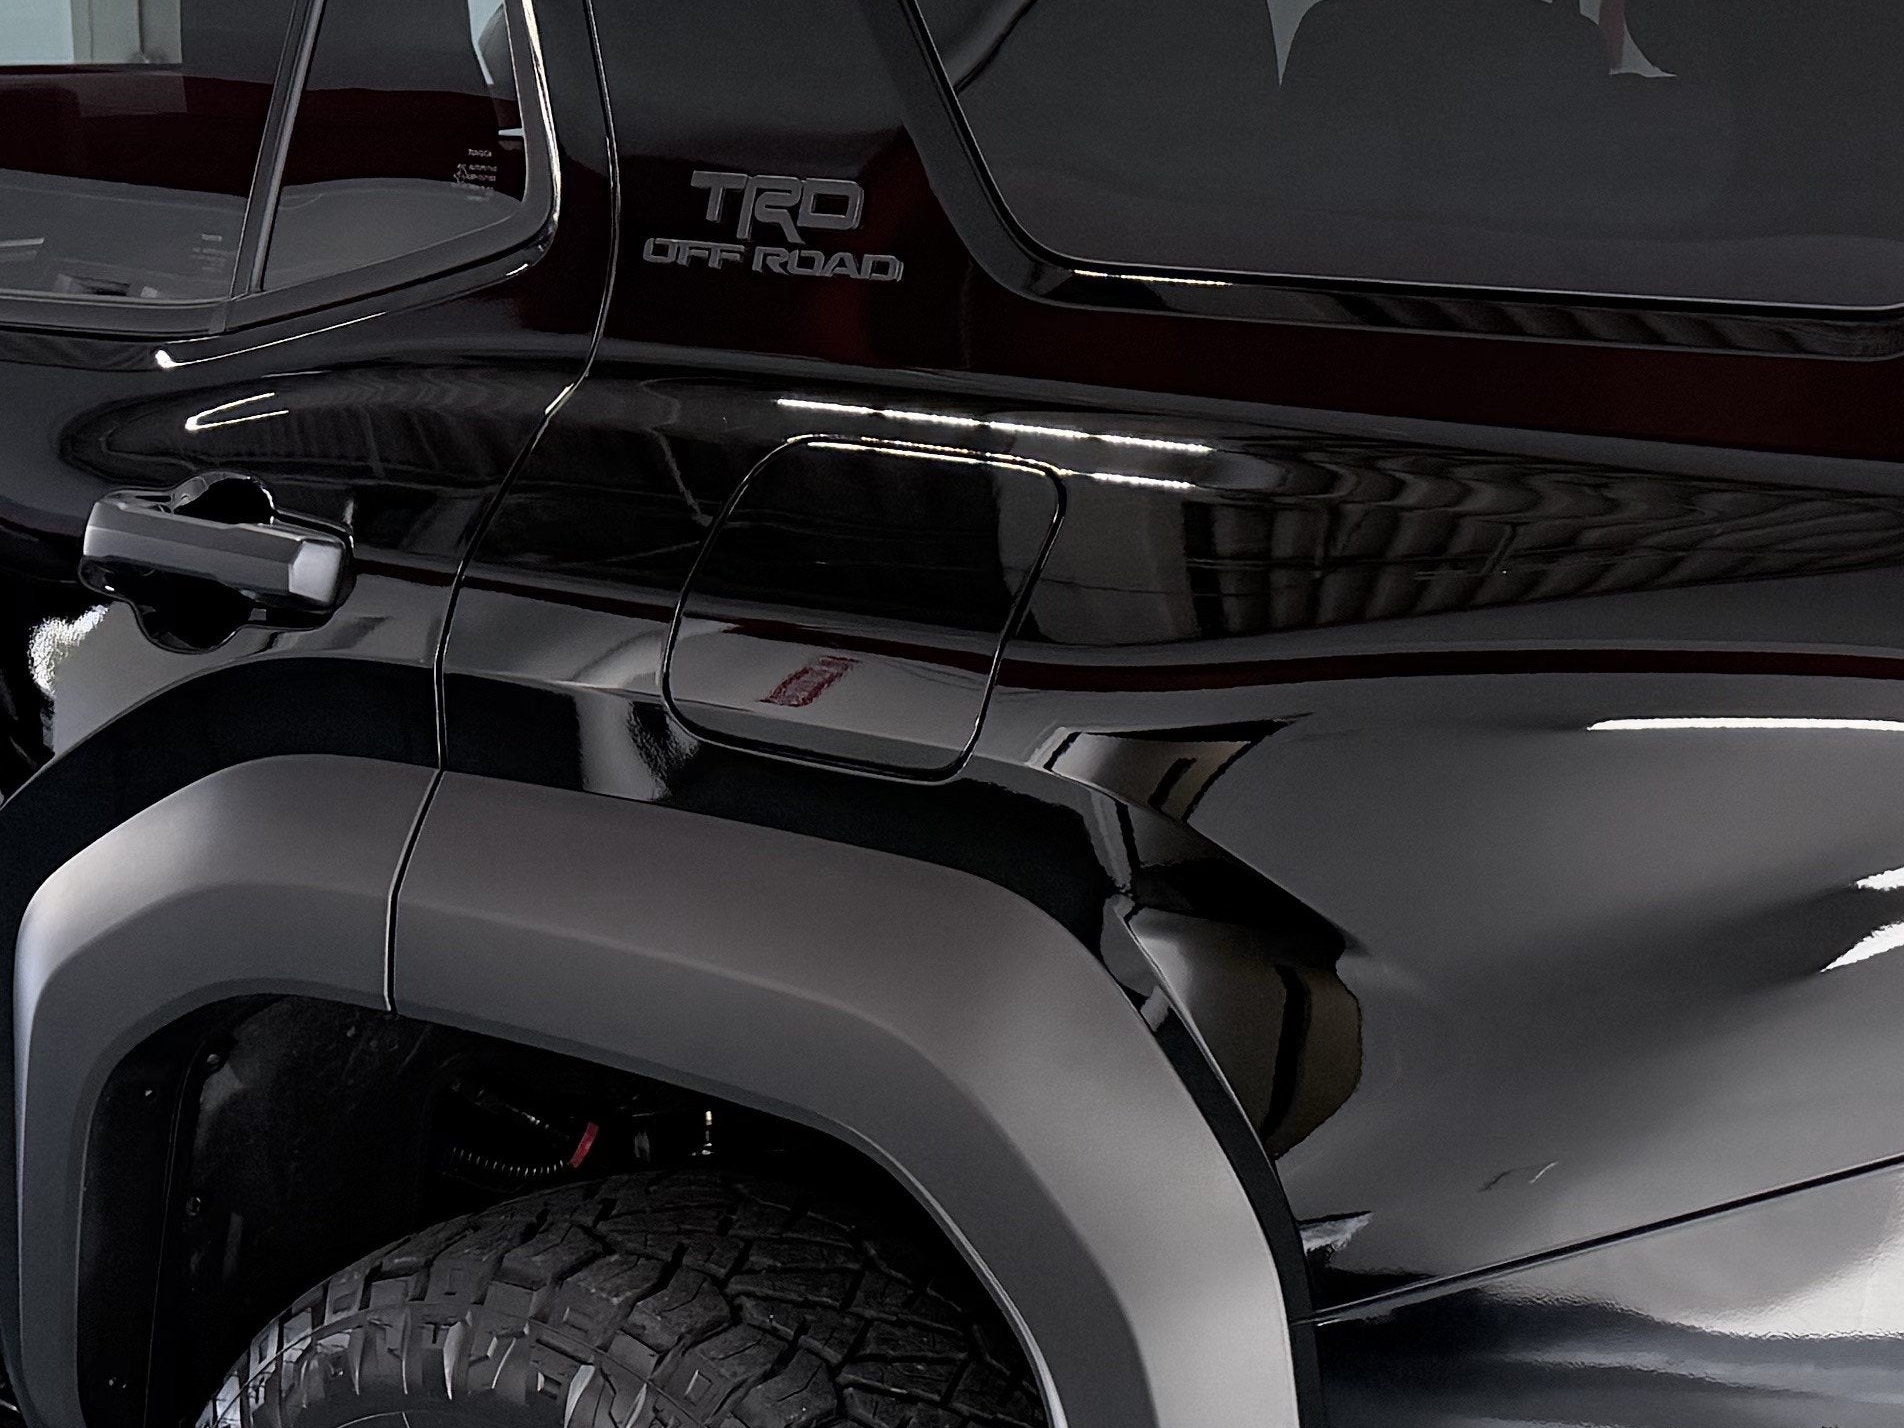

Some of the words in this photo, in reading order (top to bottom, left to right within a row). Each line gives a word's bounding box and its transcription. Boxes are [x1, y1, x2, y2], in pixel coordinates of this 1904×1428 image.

[690, 169, 865, 244] TRD
[642, 237, 745, 270] OFF
[751, 245, 904, 282] ROAD
